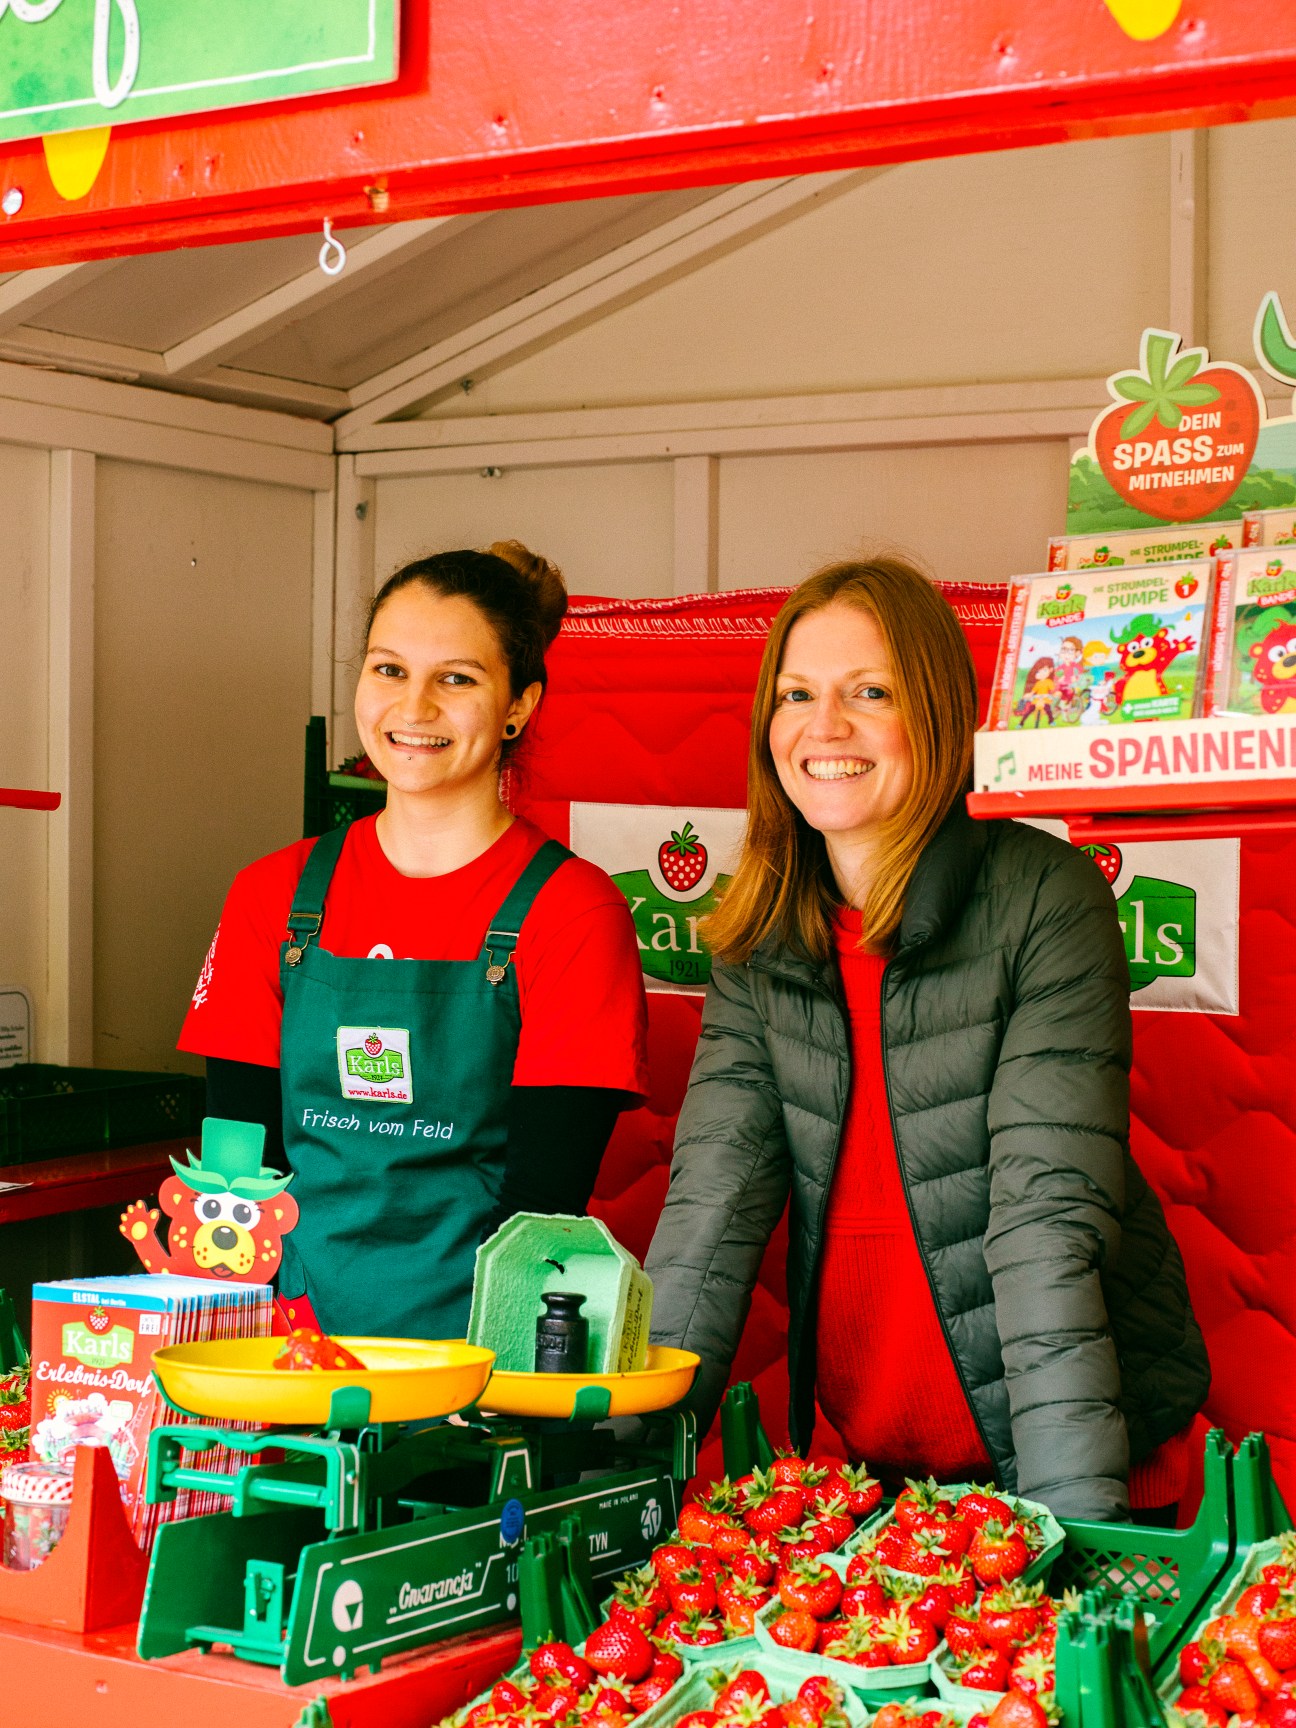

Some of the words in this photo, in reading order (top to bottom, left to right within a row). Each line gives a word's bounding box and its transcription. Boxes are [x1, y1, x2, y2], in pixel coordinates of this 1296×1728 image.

[1178, 411, 1221, 432] DEIN
[1112, 435, 1213, 471] SPASS
[1216, 442, 1244, 457] ZUM
[1128, 466, 1235, 491] MITNEHMEN
[1143, 540, 1204, 557] STRUMPEL-
[1107, 577, 1169, 594] STRUMPEL-
[1180, 583, 1189, 597] 1
[1040, 598, 1084, 616] Karls
[1108, 588, 1170, 609] PUMPE
[1048, 612, 1081, 627] BANDE
[1028, 762, 1083, 782] MEINE
[1088, 727, 1296, 779] SPANNEN
[626, 897, 708, 954] Kar
[669, 959, 700, 978] 1921
[350, 1055, 400, 1076] Karls
[348, 1087, 408, 1100] www.karls.de
[302, 1108, 360, 1131] Frisch
[368, 1120, 404, 1137] vom
[412, 1119, 455, 1141] Feld
[72, 1291, 100, 1304] ELSTAL
[65, 1329, 131, 1360] Karls
[36, 1361, 154, 1398] Erlebnis-Dorf
[599, 1500, 612, 1510] MADE
[613, 1498, 619, 1506] IN
